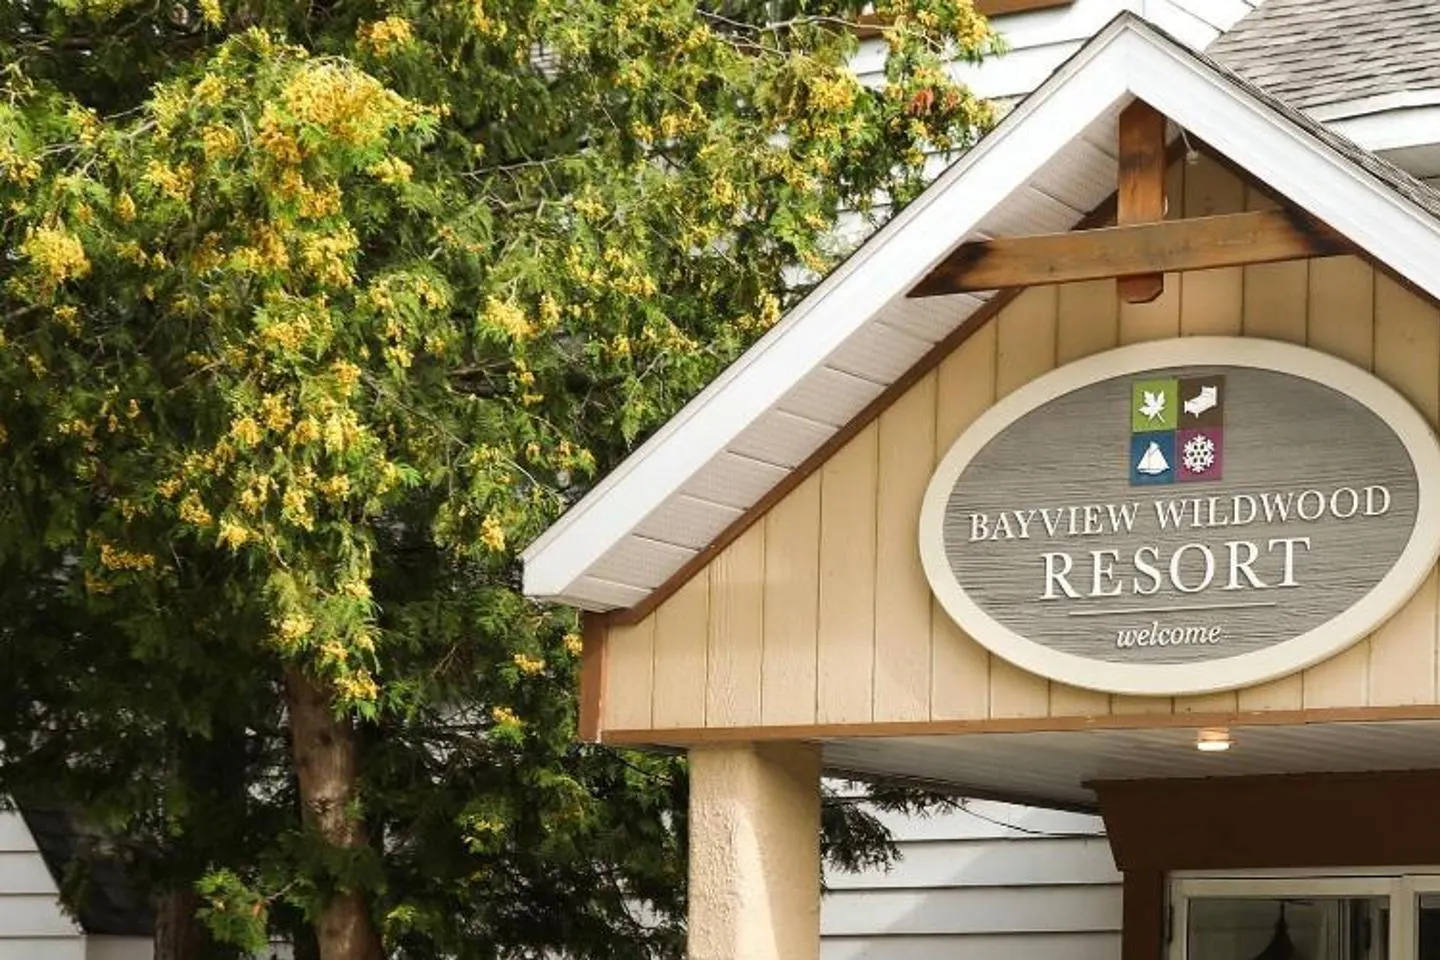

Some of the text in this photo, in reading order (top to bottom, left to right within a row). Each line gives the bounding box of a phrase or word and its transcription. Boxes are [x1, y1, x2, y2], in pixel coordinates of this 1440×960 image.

[968, 485, 1392, 542] BAYVIEW WILDWOOD
[1040, 537, 1311, 601] RESORT
[1117, 622, 1222, 648] welcome
